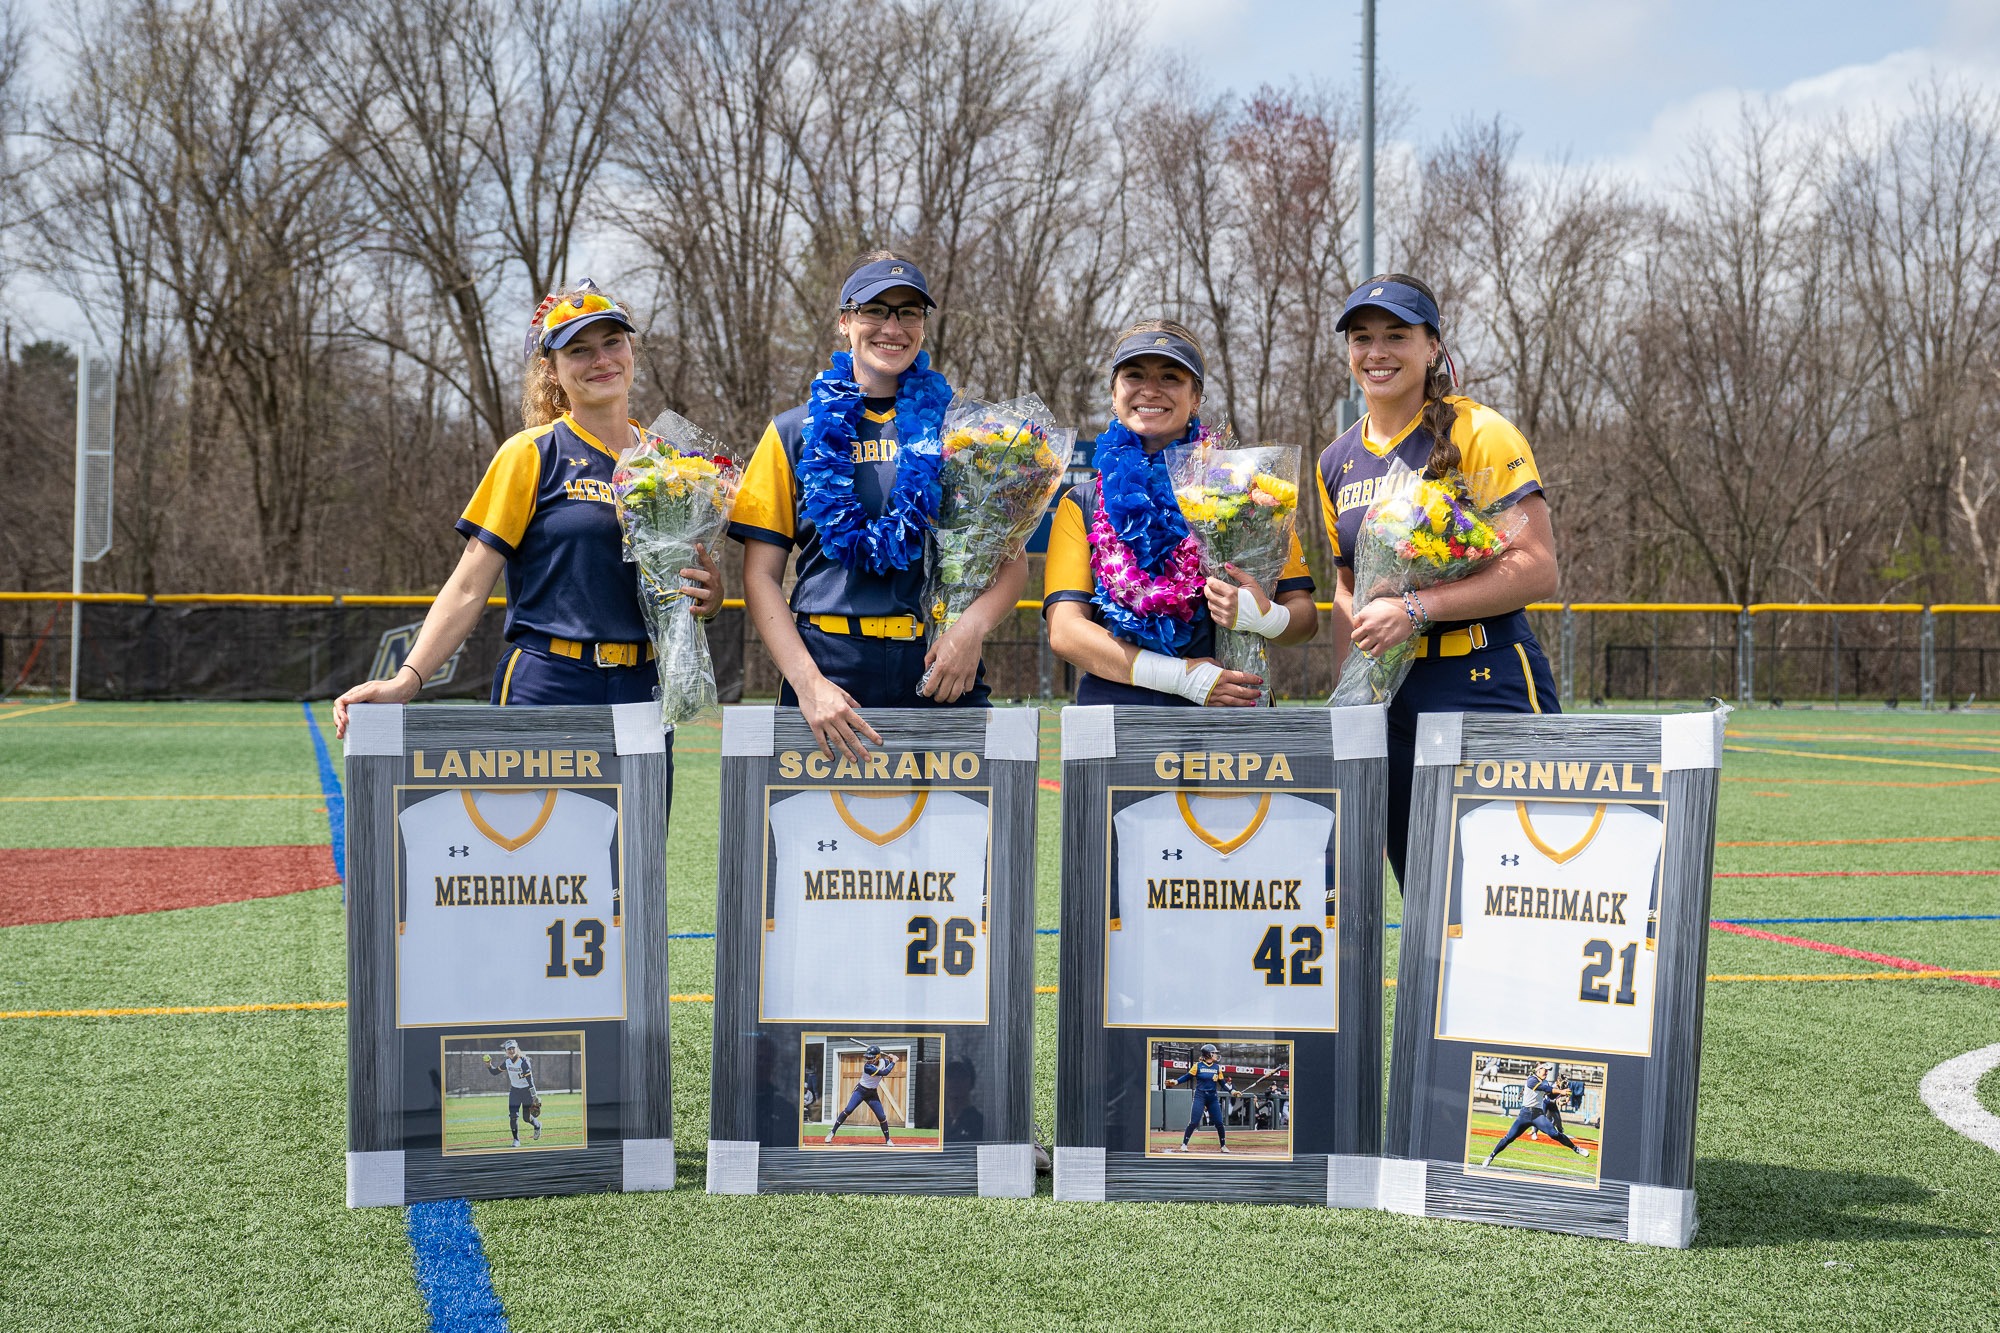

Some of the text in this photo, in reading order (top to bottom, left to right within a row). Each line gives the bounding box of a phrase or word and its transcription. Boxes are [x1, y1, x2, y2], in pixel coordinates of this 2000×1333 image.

[413, 749, 602, 778] LANPHER
[778, 750, 980, 780] SCARANO
[1154, 751, 1294, 781] CERPA
[1453, 758, 1664, 793] FORNWALT
[434, 874, 588, 906] MERRIMACK
[804, 869, 956, 902] MERRIMACK
[1147, 878, 1302, 910] MERRIMACK
[1484, 885, 1628, 925] MERRIMACK
[545, 917, 606, 978] 13
[904, 915, 976, 977] 26
[1251, 924, 1324, 986] 42
[1578, 937, 1639, 1007] 21
